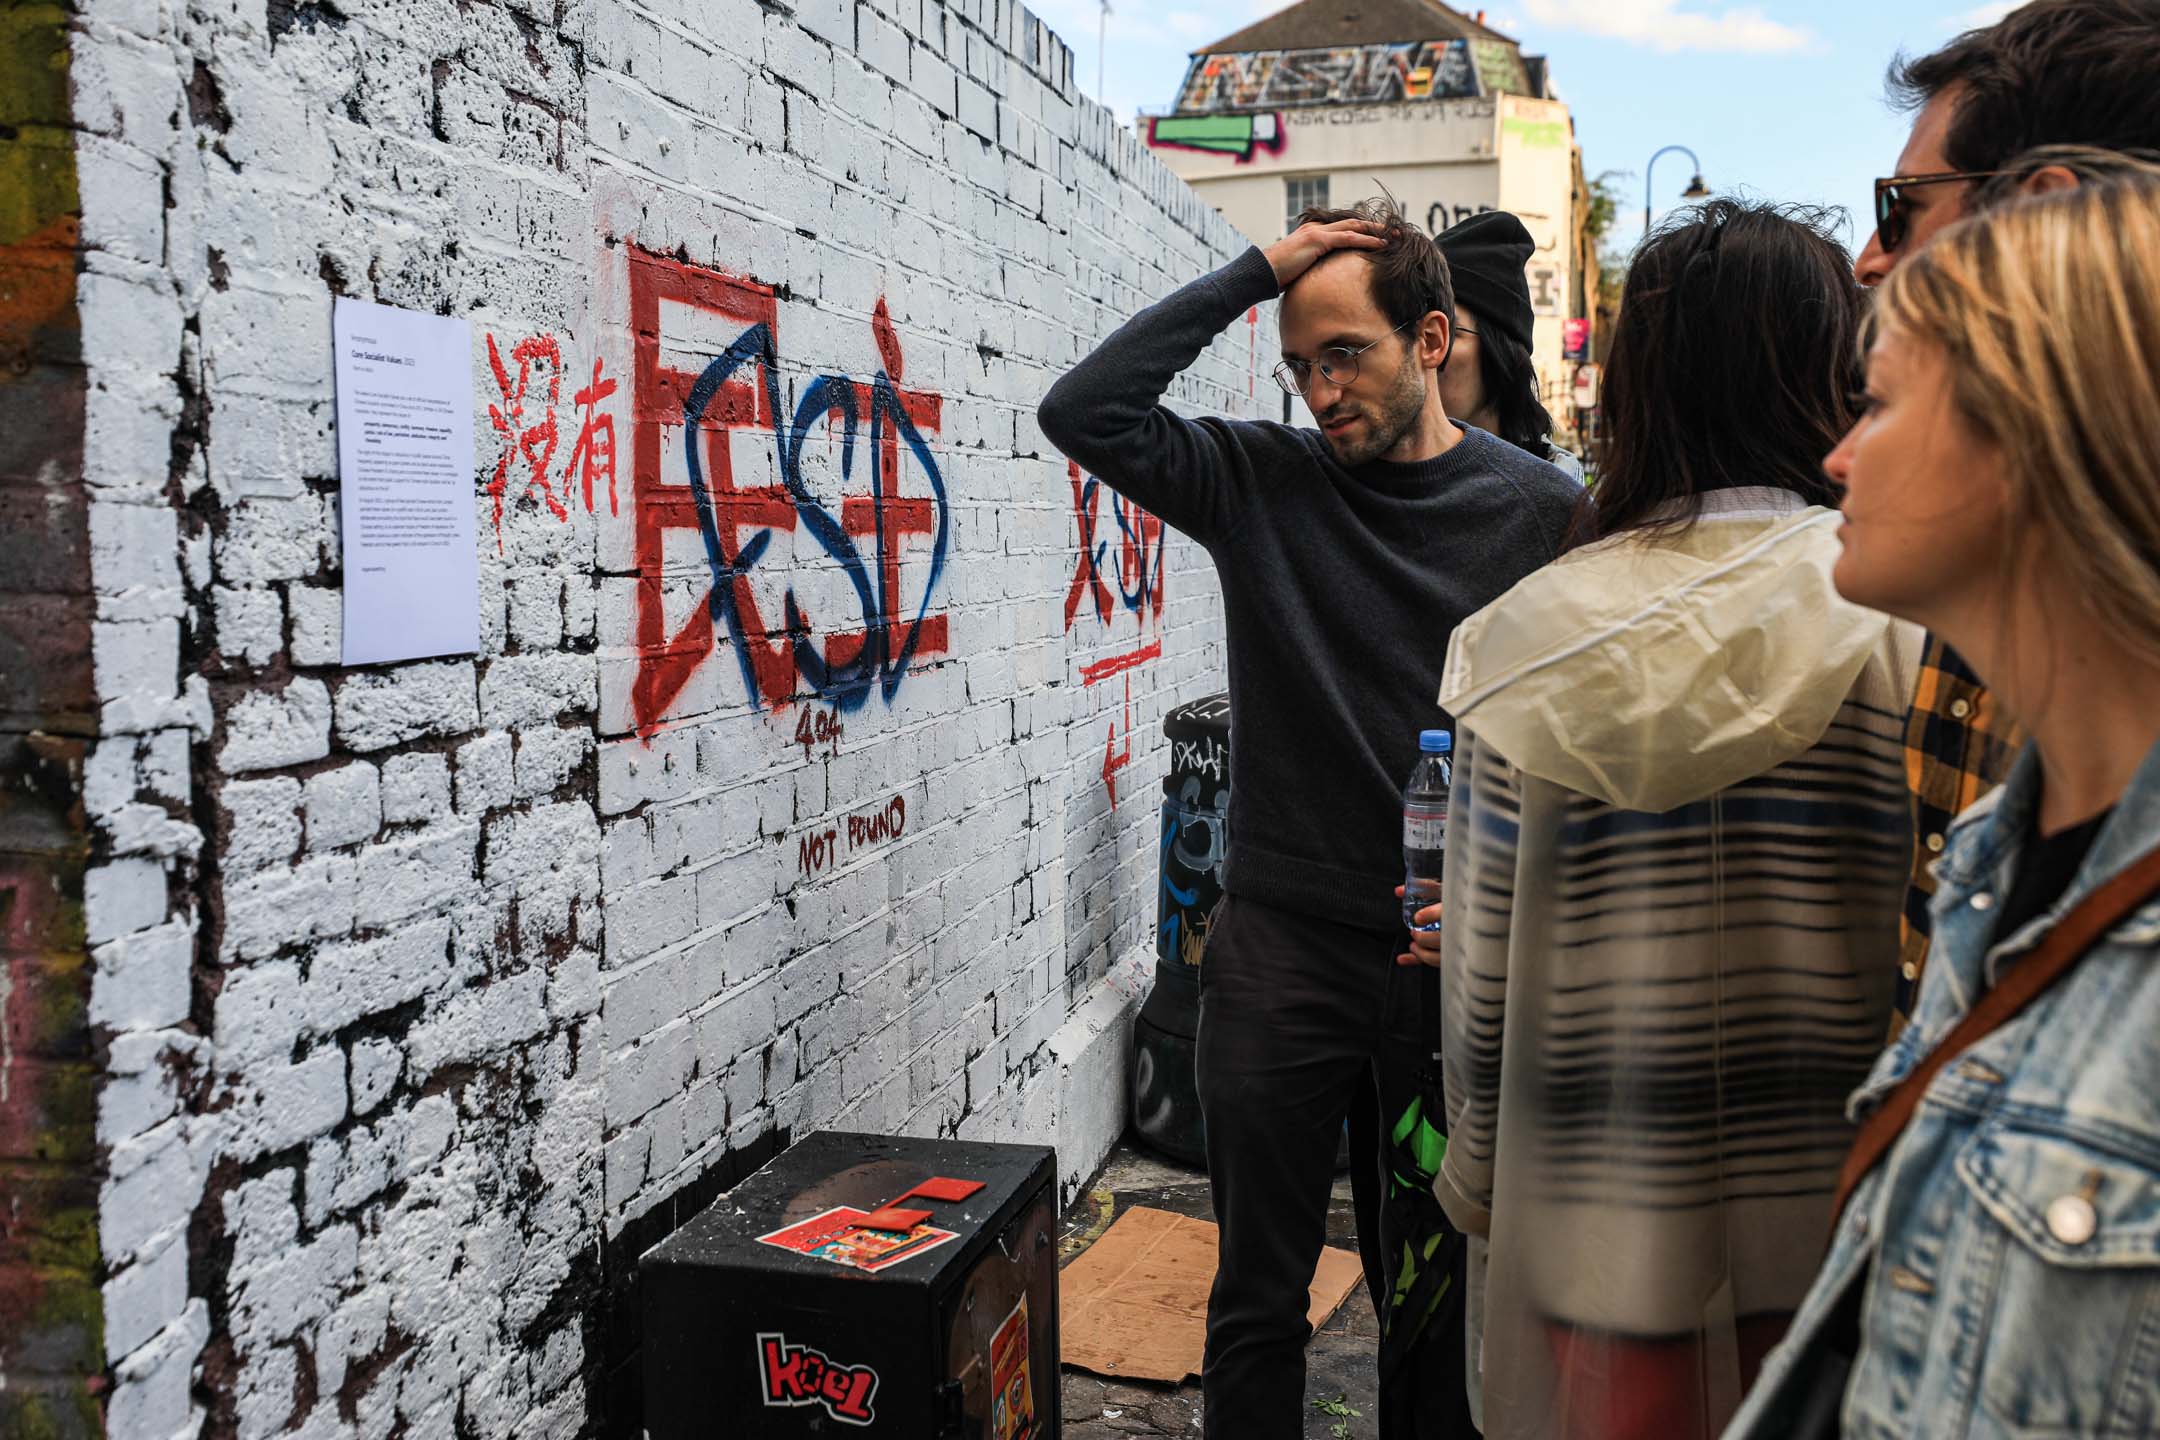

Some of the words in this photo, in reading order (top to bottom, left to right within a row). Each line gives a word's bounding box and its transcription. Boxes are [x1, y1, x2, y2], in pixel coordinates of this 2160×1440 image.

[486, 331, 619, 557] 没有
[795, 702, 842, 763] 404
[799, 831, 837, 880] NOT
